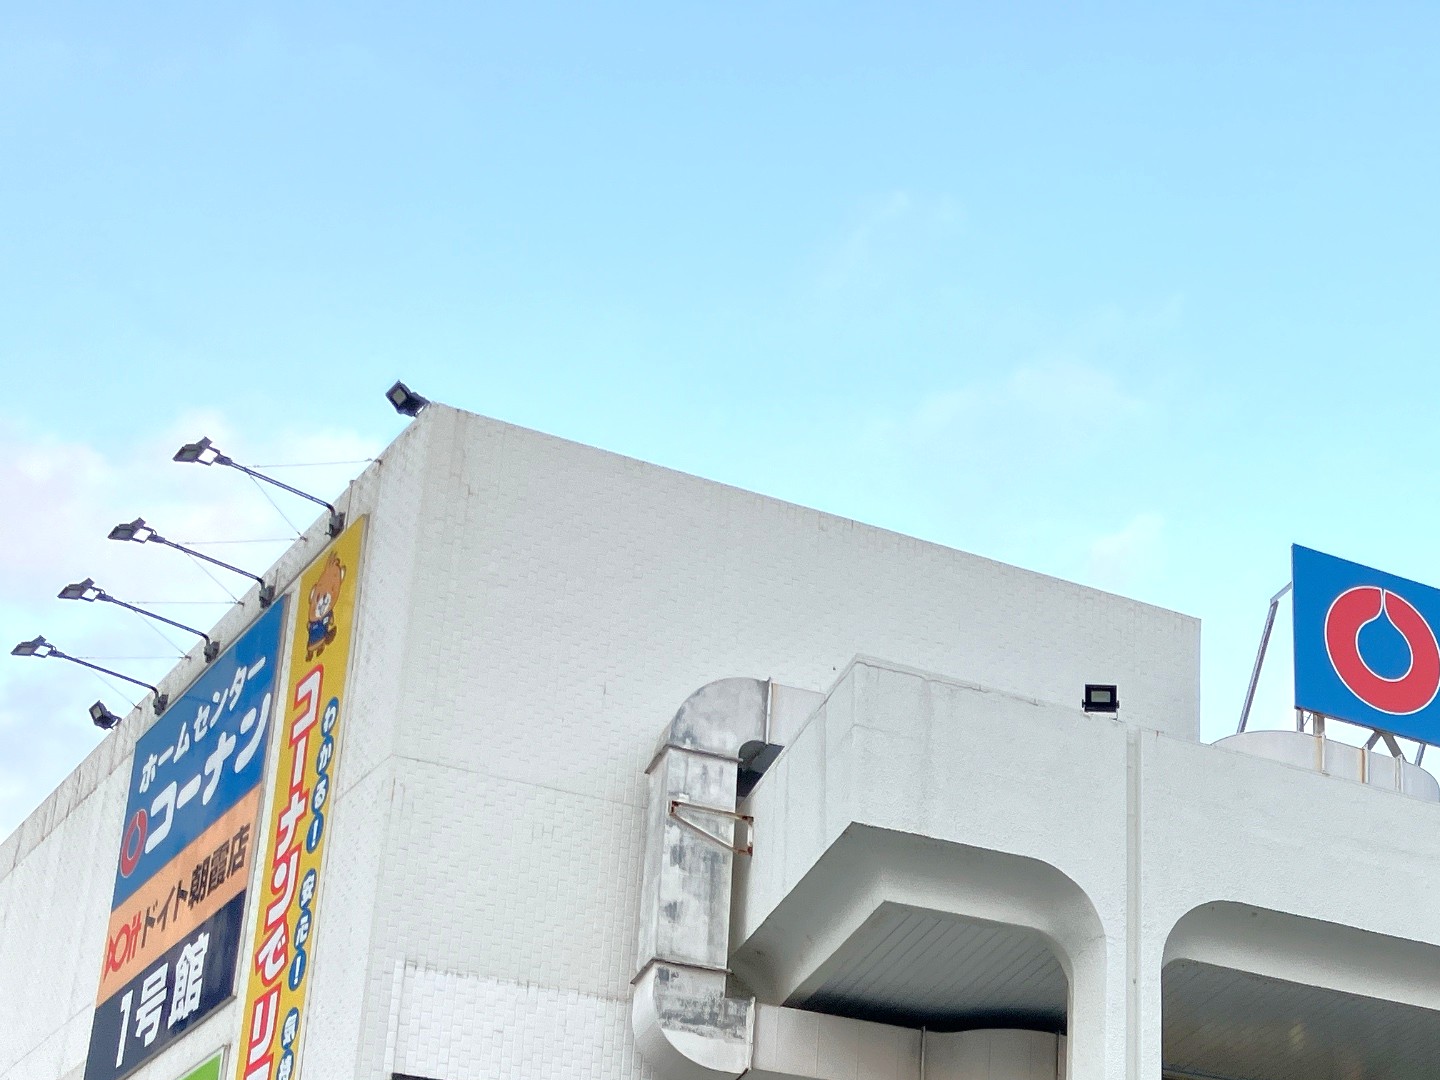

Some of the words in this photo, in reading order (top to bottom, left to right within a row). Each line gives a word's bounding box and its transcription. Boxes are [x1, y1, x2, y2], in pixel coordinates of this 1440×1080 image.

[139, 656, 266, 793] ホームセンター
[145, 693, 271, 854] コーナン
[142, 826, 249, 949] ドイト朝霞店
[116, 932, 210, 1068] 1号館
